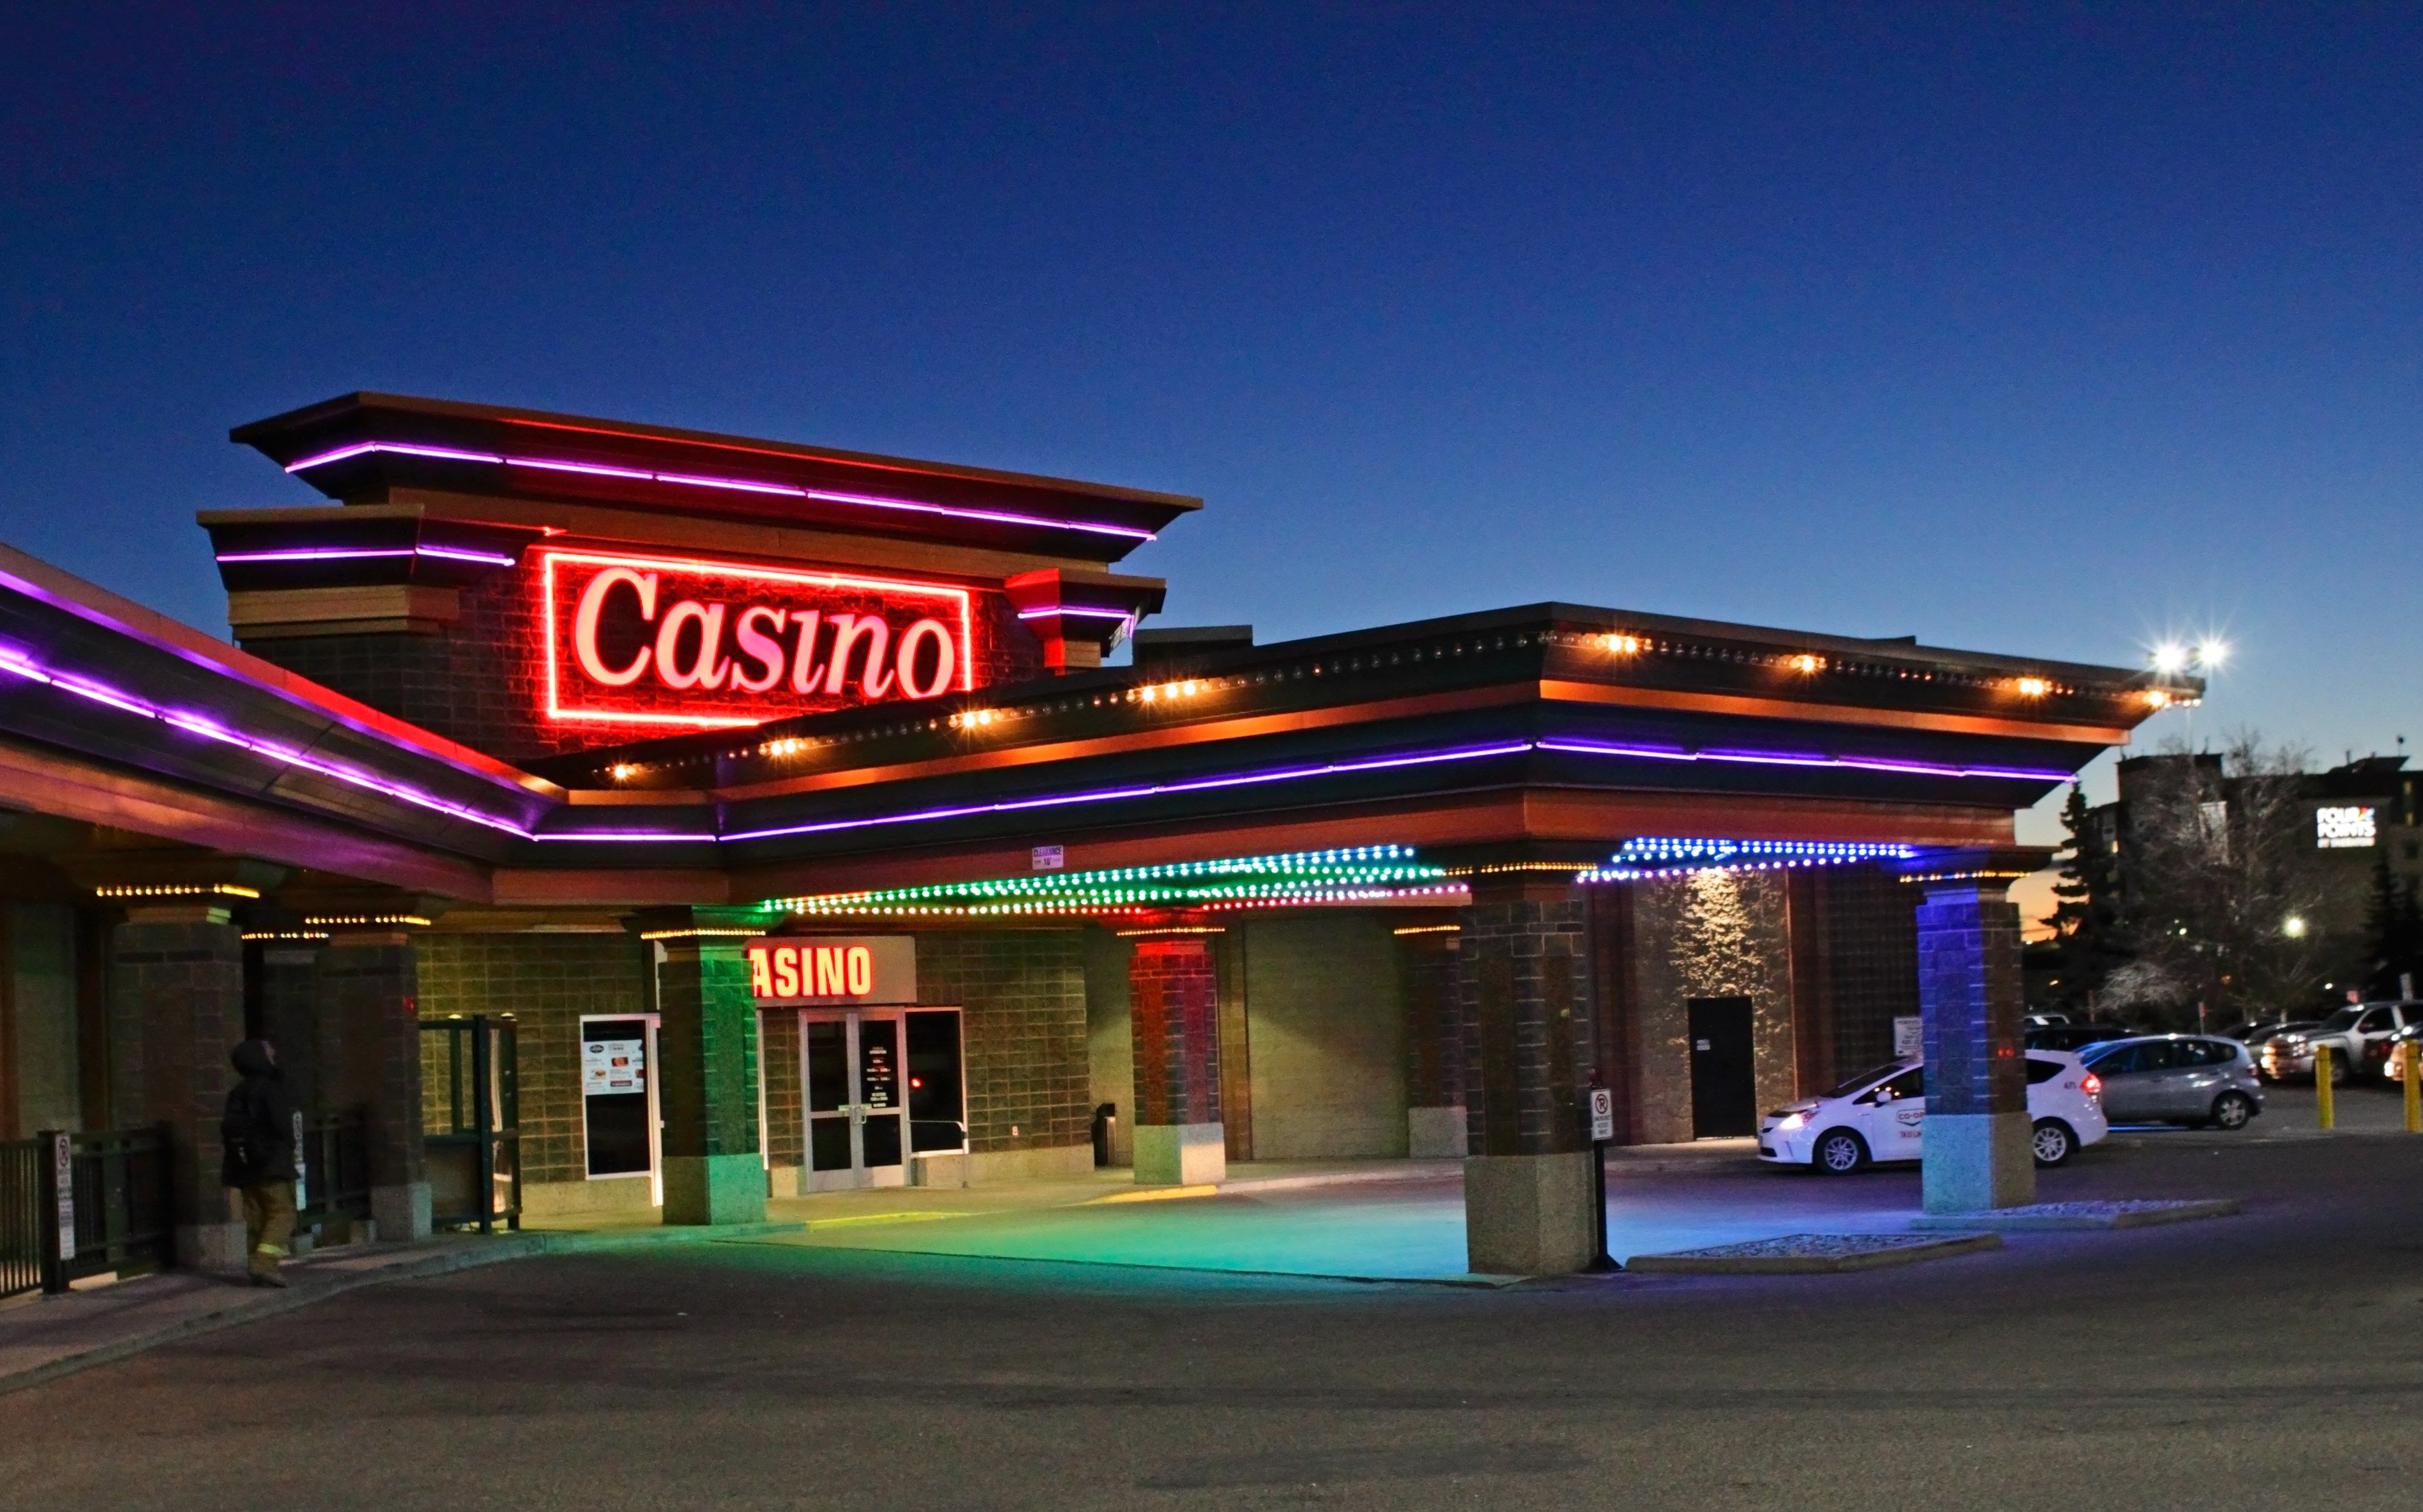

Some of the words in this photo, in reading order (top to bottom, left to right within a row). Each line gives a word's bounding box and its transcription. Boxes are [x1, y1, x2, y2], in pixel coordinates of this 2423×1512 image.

[575, 566, 955, 700] Casino
[2317, 806, 2360, 823] FOUR
[2317, 821, 2377, 839] POINTS
[749, 946, 872, 997] ASINO
